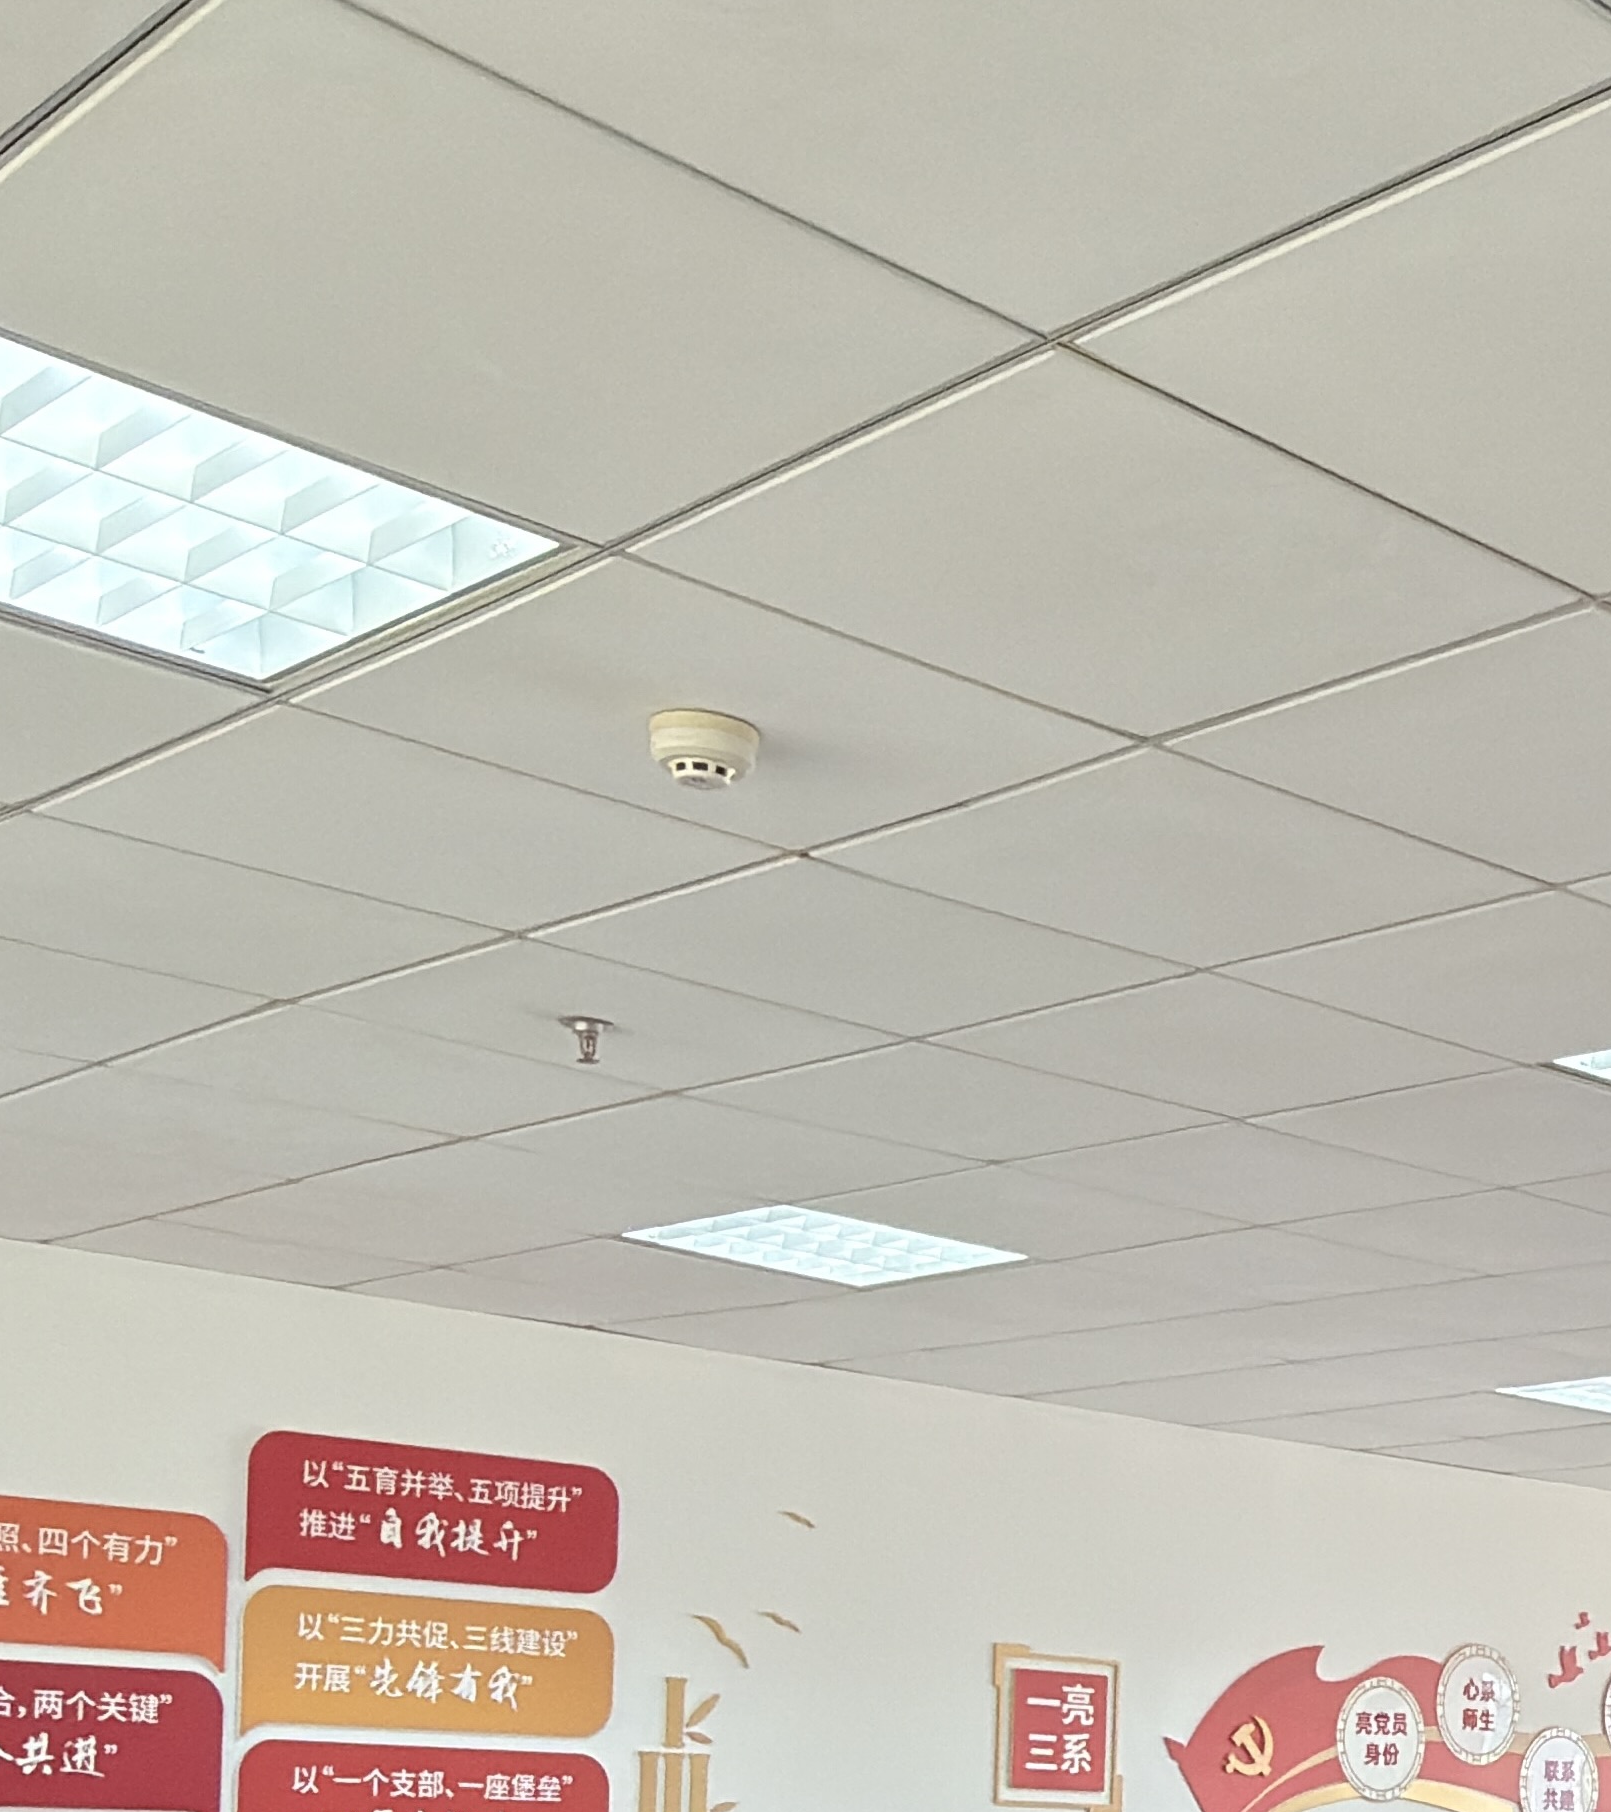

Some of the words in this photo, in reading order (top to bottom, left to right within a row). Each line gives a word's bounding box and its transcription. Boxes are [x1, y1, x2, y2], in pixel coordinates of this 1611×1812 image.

[302, 1459, 583, 1512] 以“五育并举、五项提升”
[298, 1612, 578, 1659] 以“三力共促、三线建设”
[1462, 1678, 1496, 1702] 心系
[1026, 1684, 1096, 1727] 一亮
[1355, 1711, 1409, 1737] 亮党员
[1462, 1707, 1496, 1733] 师生
[1024, 1733, 1094, 1775] 三系
[1363, 1743, 1400, 1767] 身份
[292, 1765, 573, 1802] 以“一个支部、一座堡垒”
[1543, 1760, 1576, 1783] 联系
[1543, 1787, 1575, 1812] 共建
